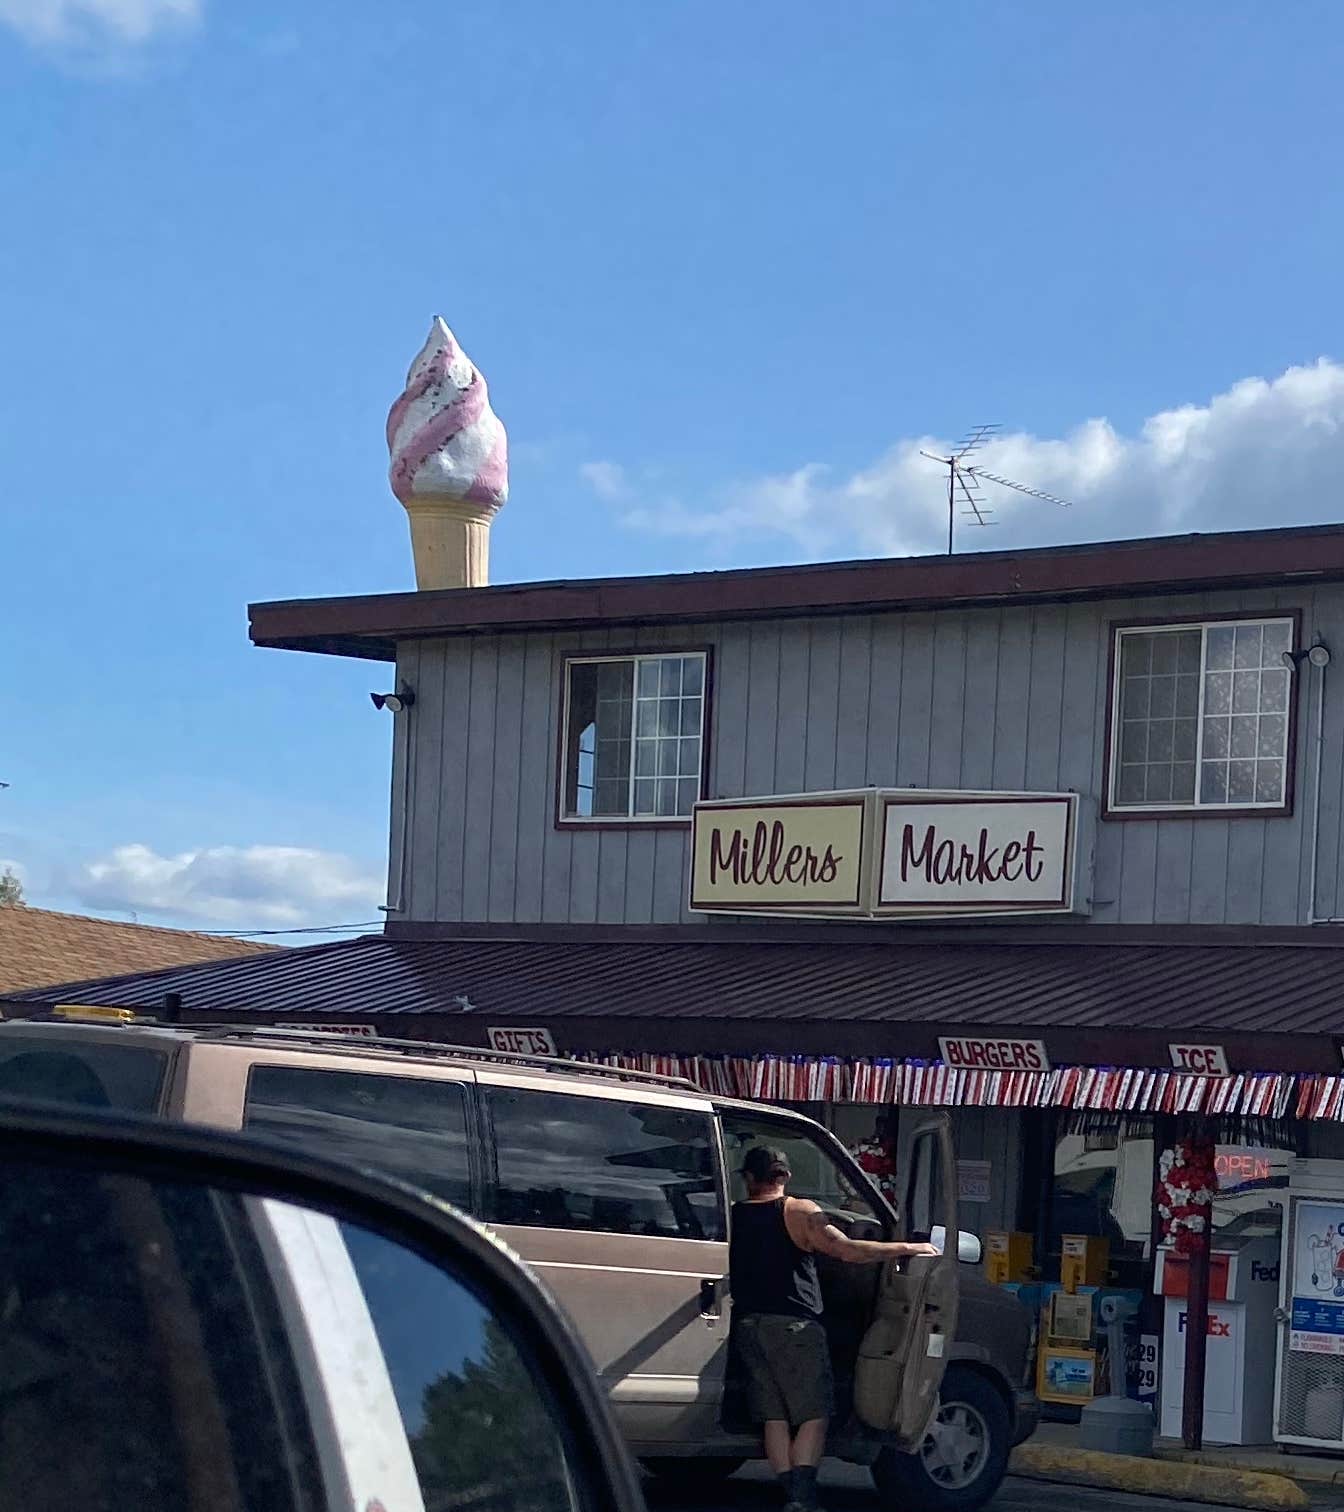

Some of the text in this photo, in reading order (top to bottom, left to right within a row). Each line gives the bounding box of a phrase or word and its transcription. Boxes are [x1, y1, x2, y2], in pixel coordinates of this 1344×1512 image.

[710, 820, 843, 887] Millers
[901, 824, 1044, 886] Market
[492, 1030, 551, 1055] GIFTS
[945, 1039, 1042, 1069] BURGERS
[1177, 1047, 1221, 1075] ICE
[1214, 1155, 1270, 1180] OPEN
[1178, 1311, 1230, 1337] FEx
